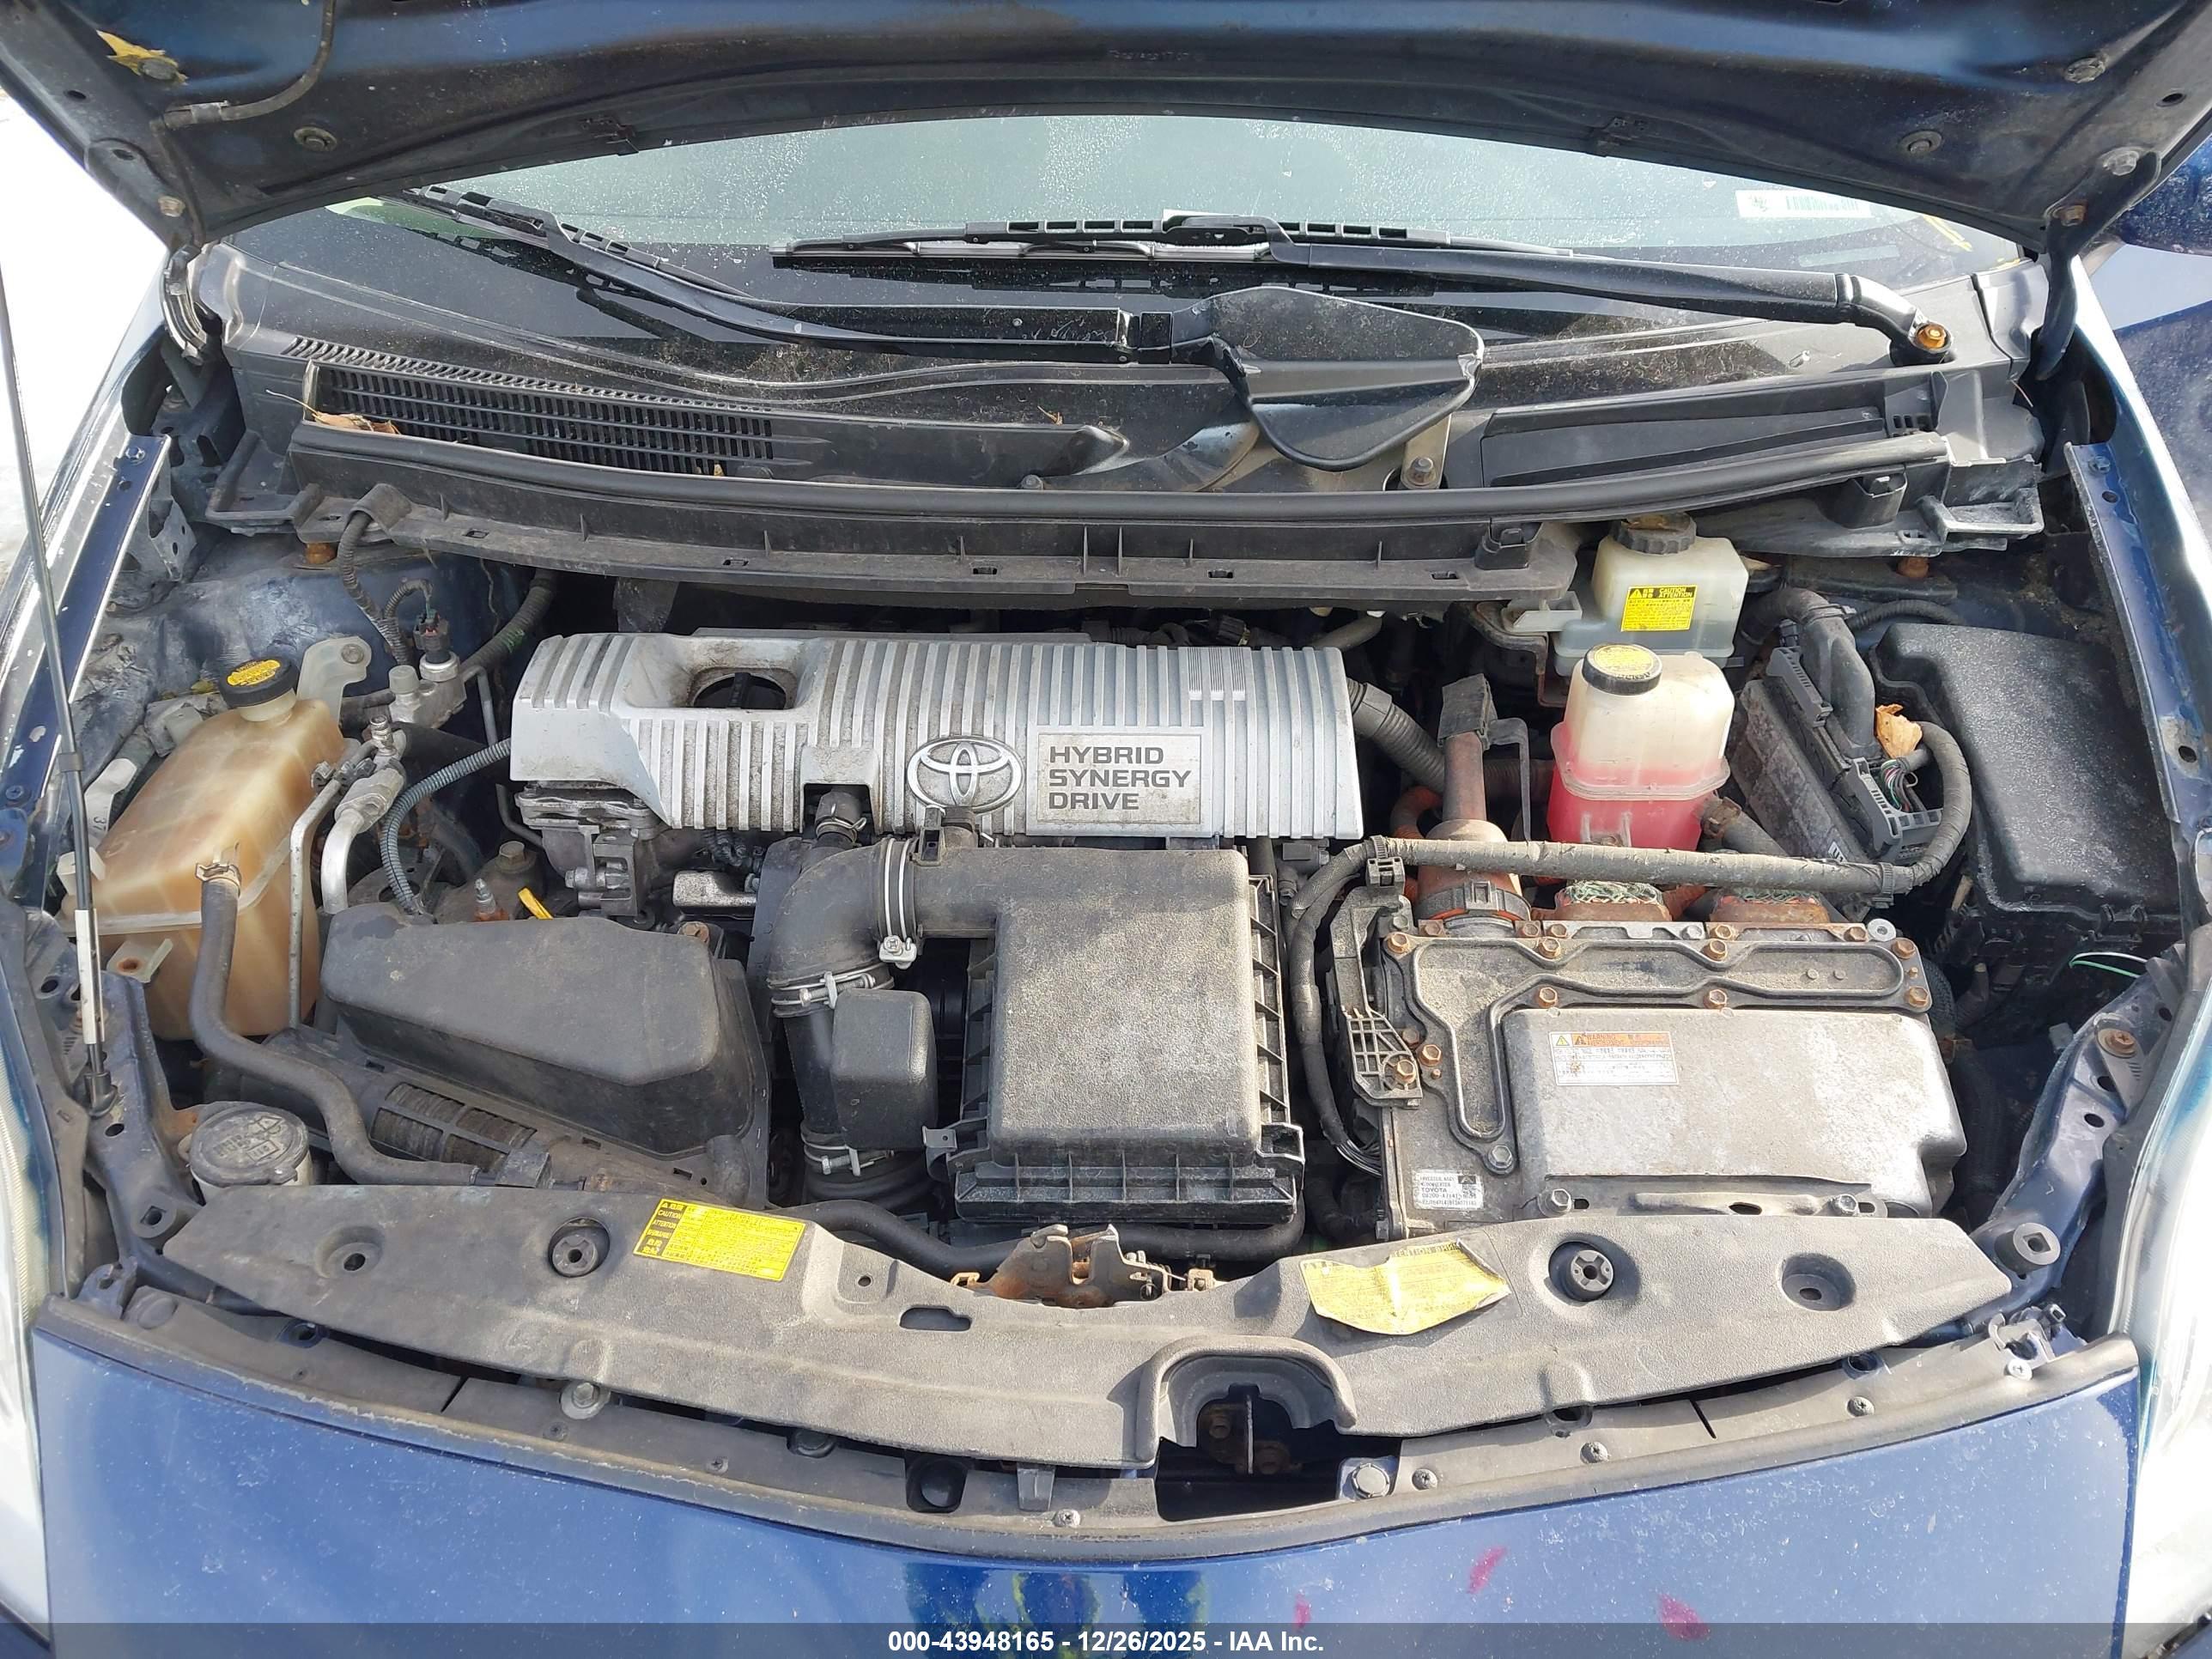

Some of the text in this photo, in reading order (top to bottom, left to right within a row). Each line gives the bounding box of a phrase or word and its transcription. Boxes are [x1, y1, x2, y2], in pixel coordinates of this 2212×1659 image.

[1049, 746, 1164, 764] HYBRID
[1048, 769, 1192, 787] SYNERGY
[1048, 793, 1139, 810] DRIVE
[658, 1210, 681, 1219] CAUTION
[653, 1219, 677, 1229] ATTENTION
